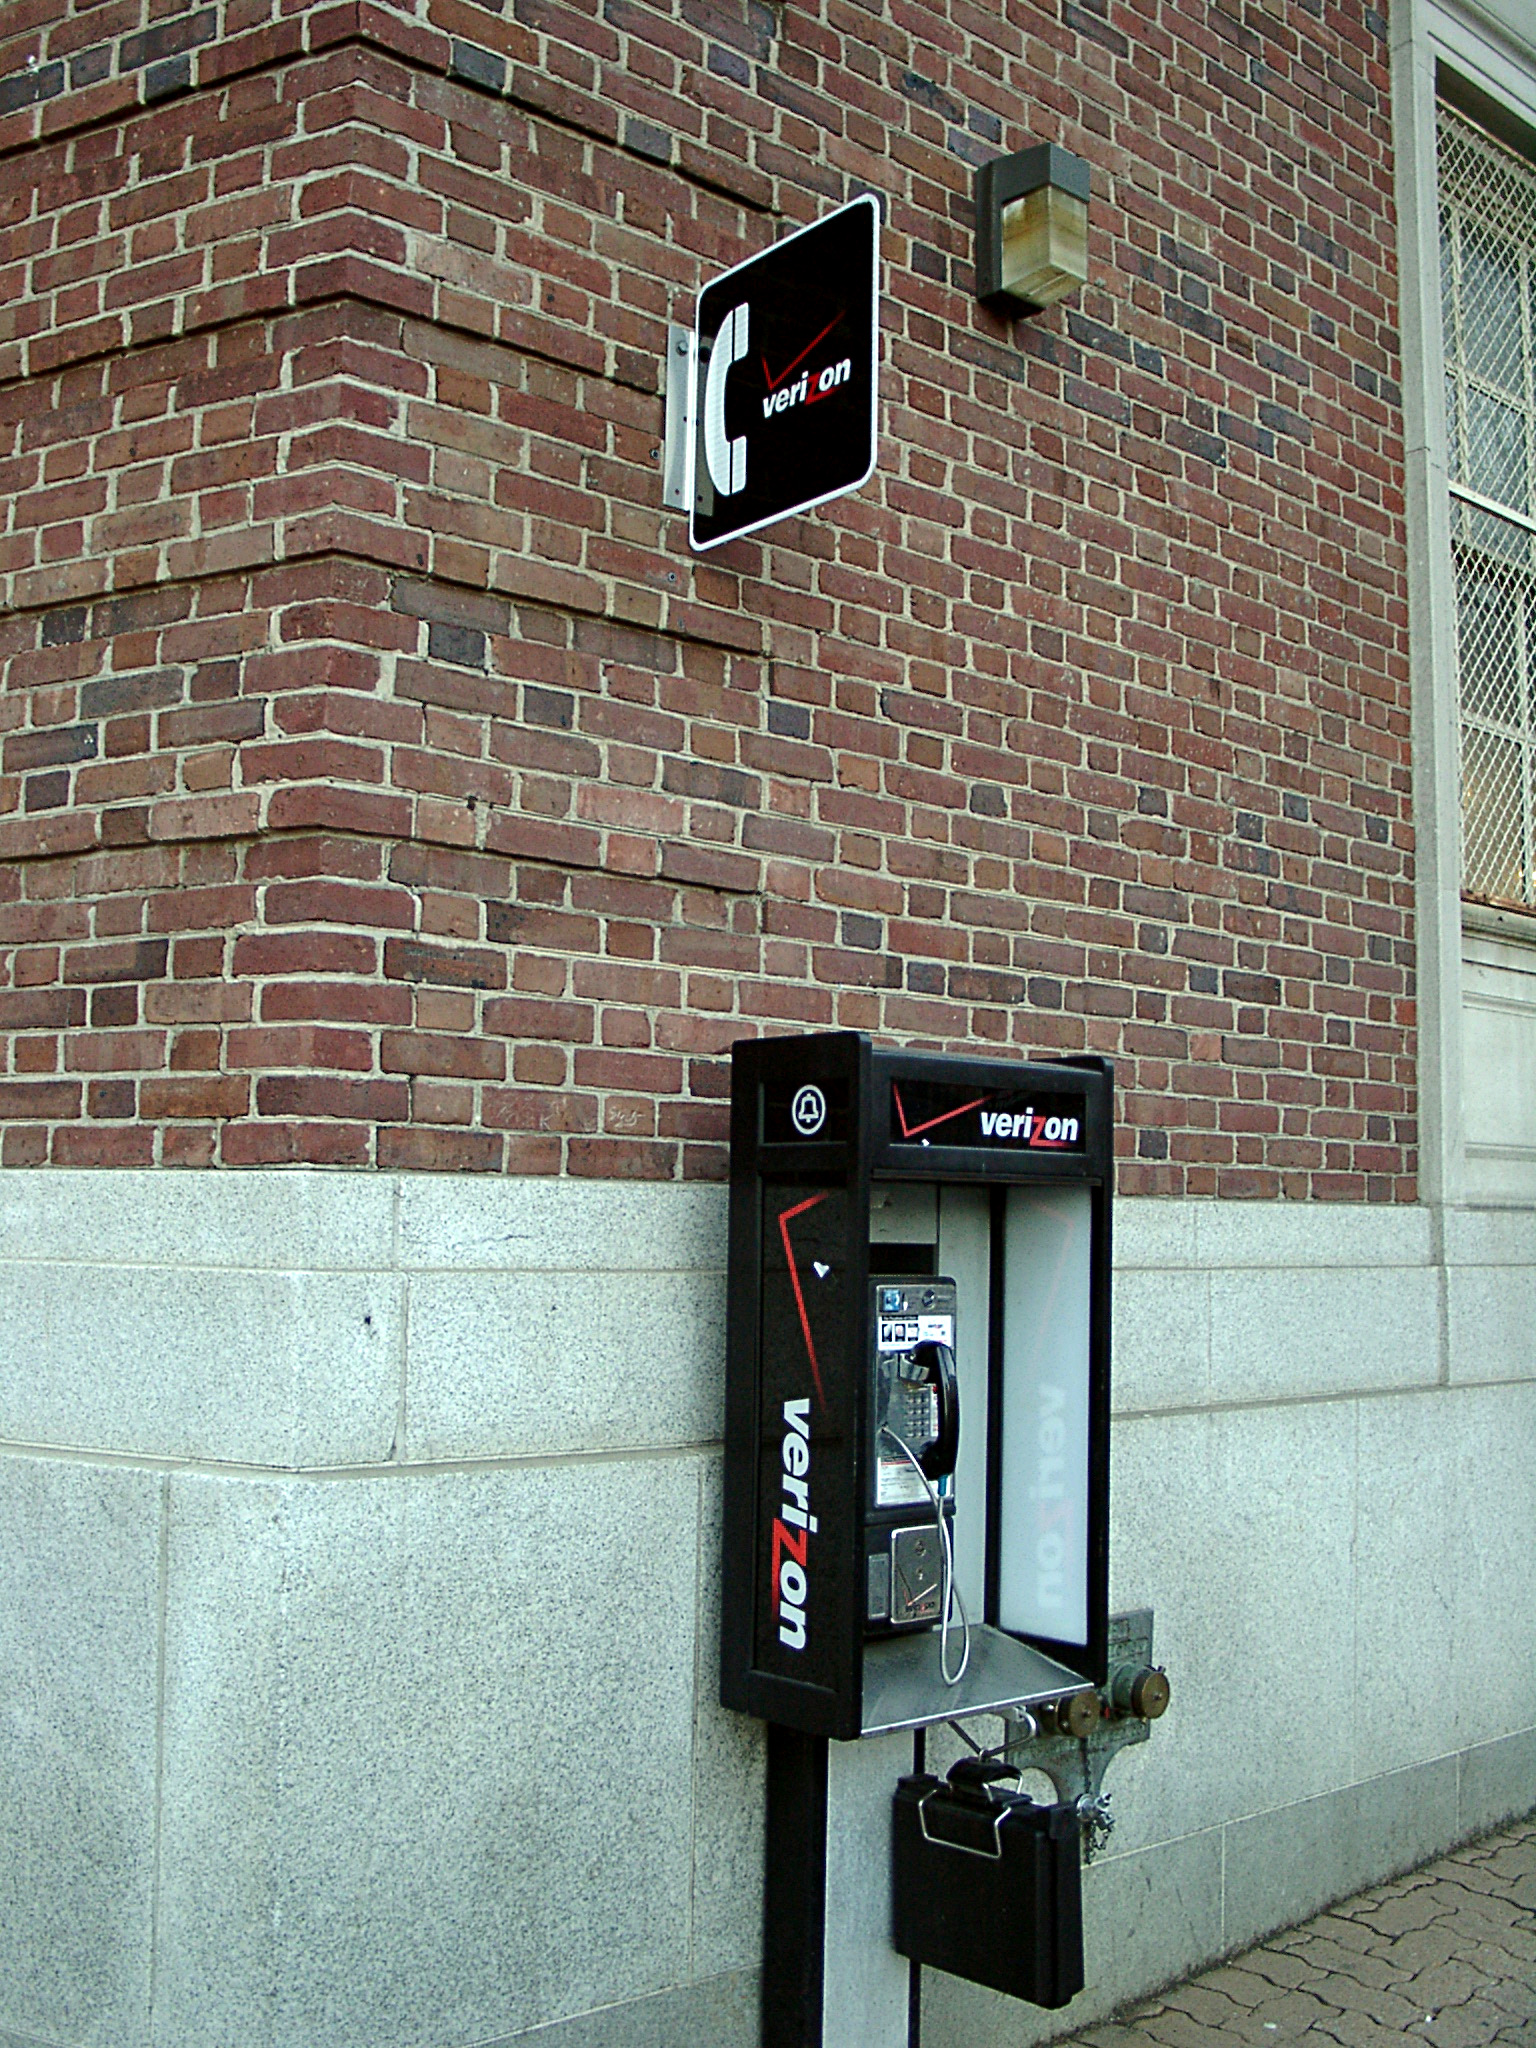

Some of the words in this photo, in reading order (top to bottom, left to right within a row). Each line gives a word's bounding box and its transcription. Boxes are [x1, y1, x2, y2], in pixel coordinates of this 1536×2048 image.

[763, 358, 851, 419] verizon
[981, 1106, 1079, 1147] verizon
[771, 1398, 818, 1650] verizon
